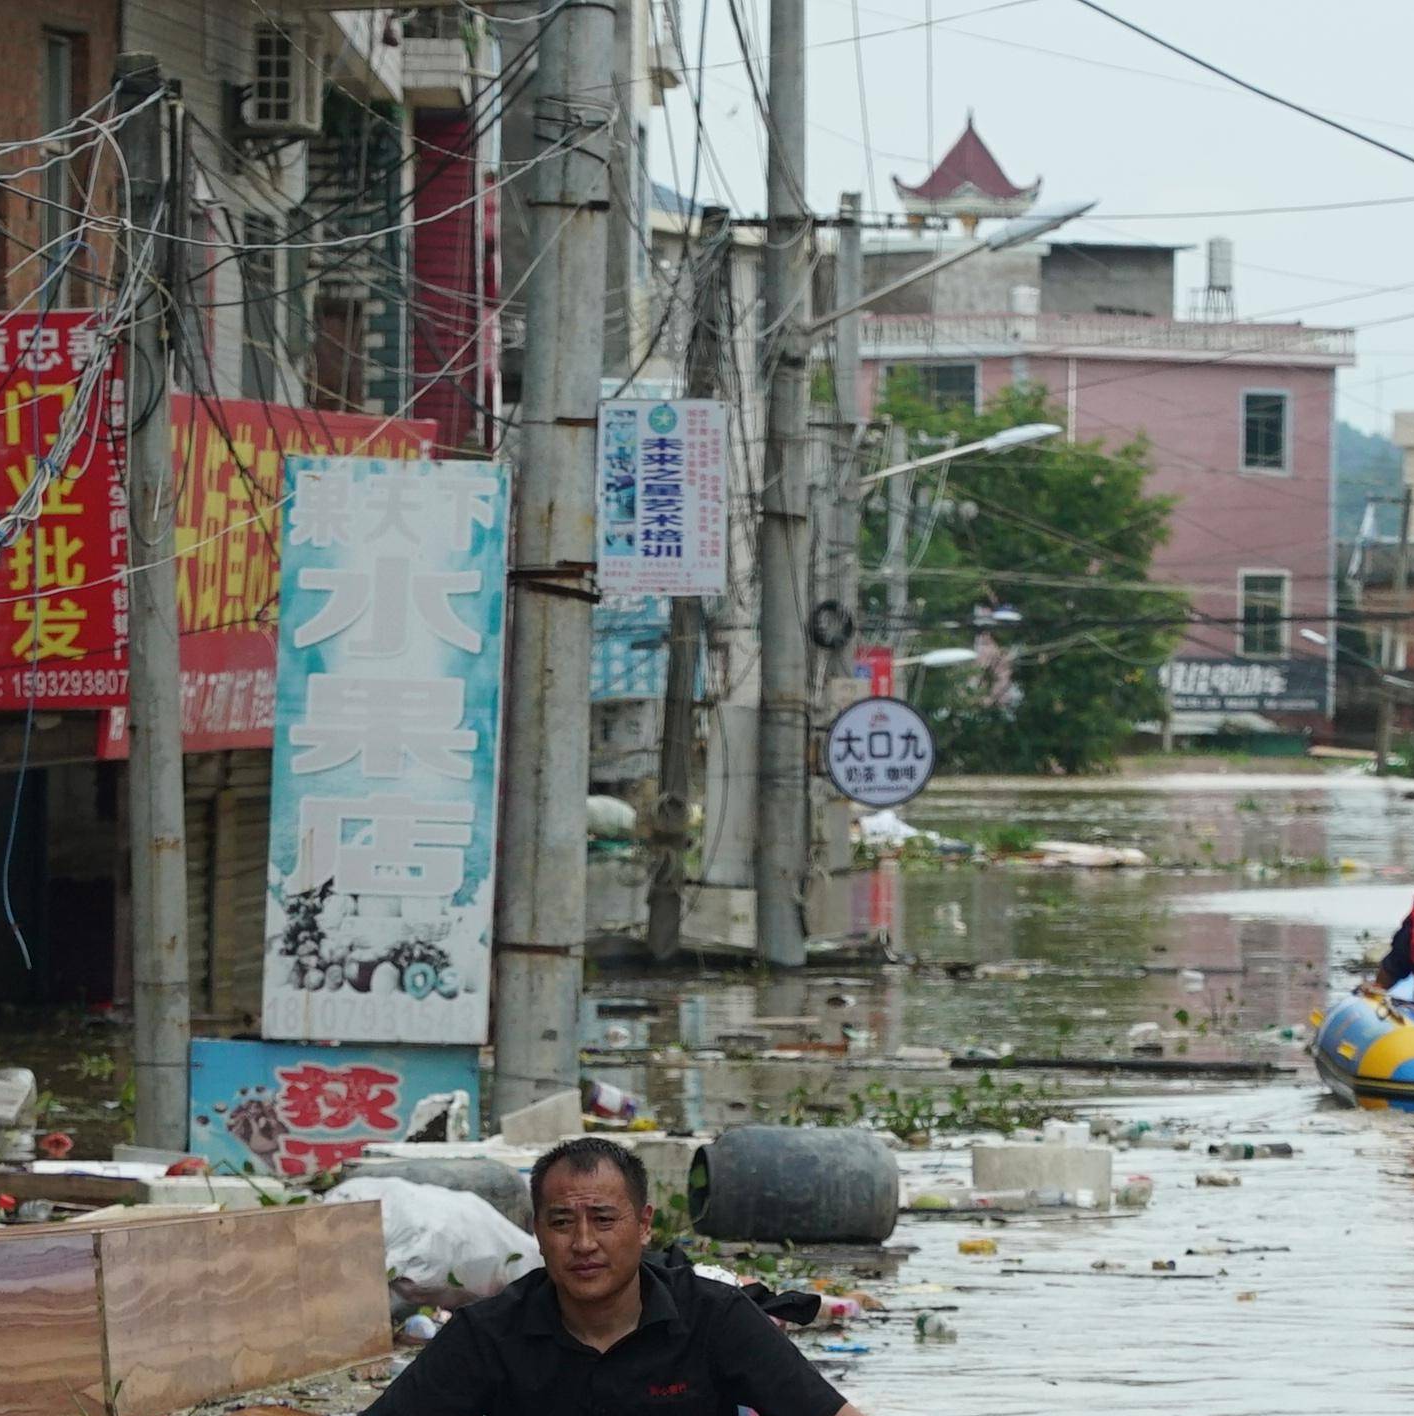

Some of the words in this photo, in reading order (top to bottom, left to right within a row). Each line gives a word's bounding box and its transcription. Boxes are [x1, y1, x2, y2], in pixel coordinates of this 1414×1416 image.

[289, 471, 499, 550] 果天下
[640, 437, 685, 558] 未来之星艺术培训
[289, 555, 483, 900] 水果店
[835, 729, 927, 762] 大口九
[845, 766, 876, 782] 奶茶
[886, 765, 917, 782] 咖啡
